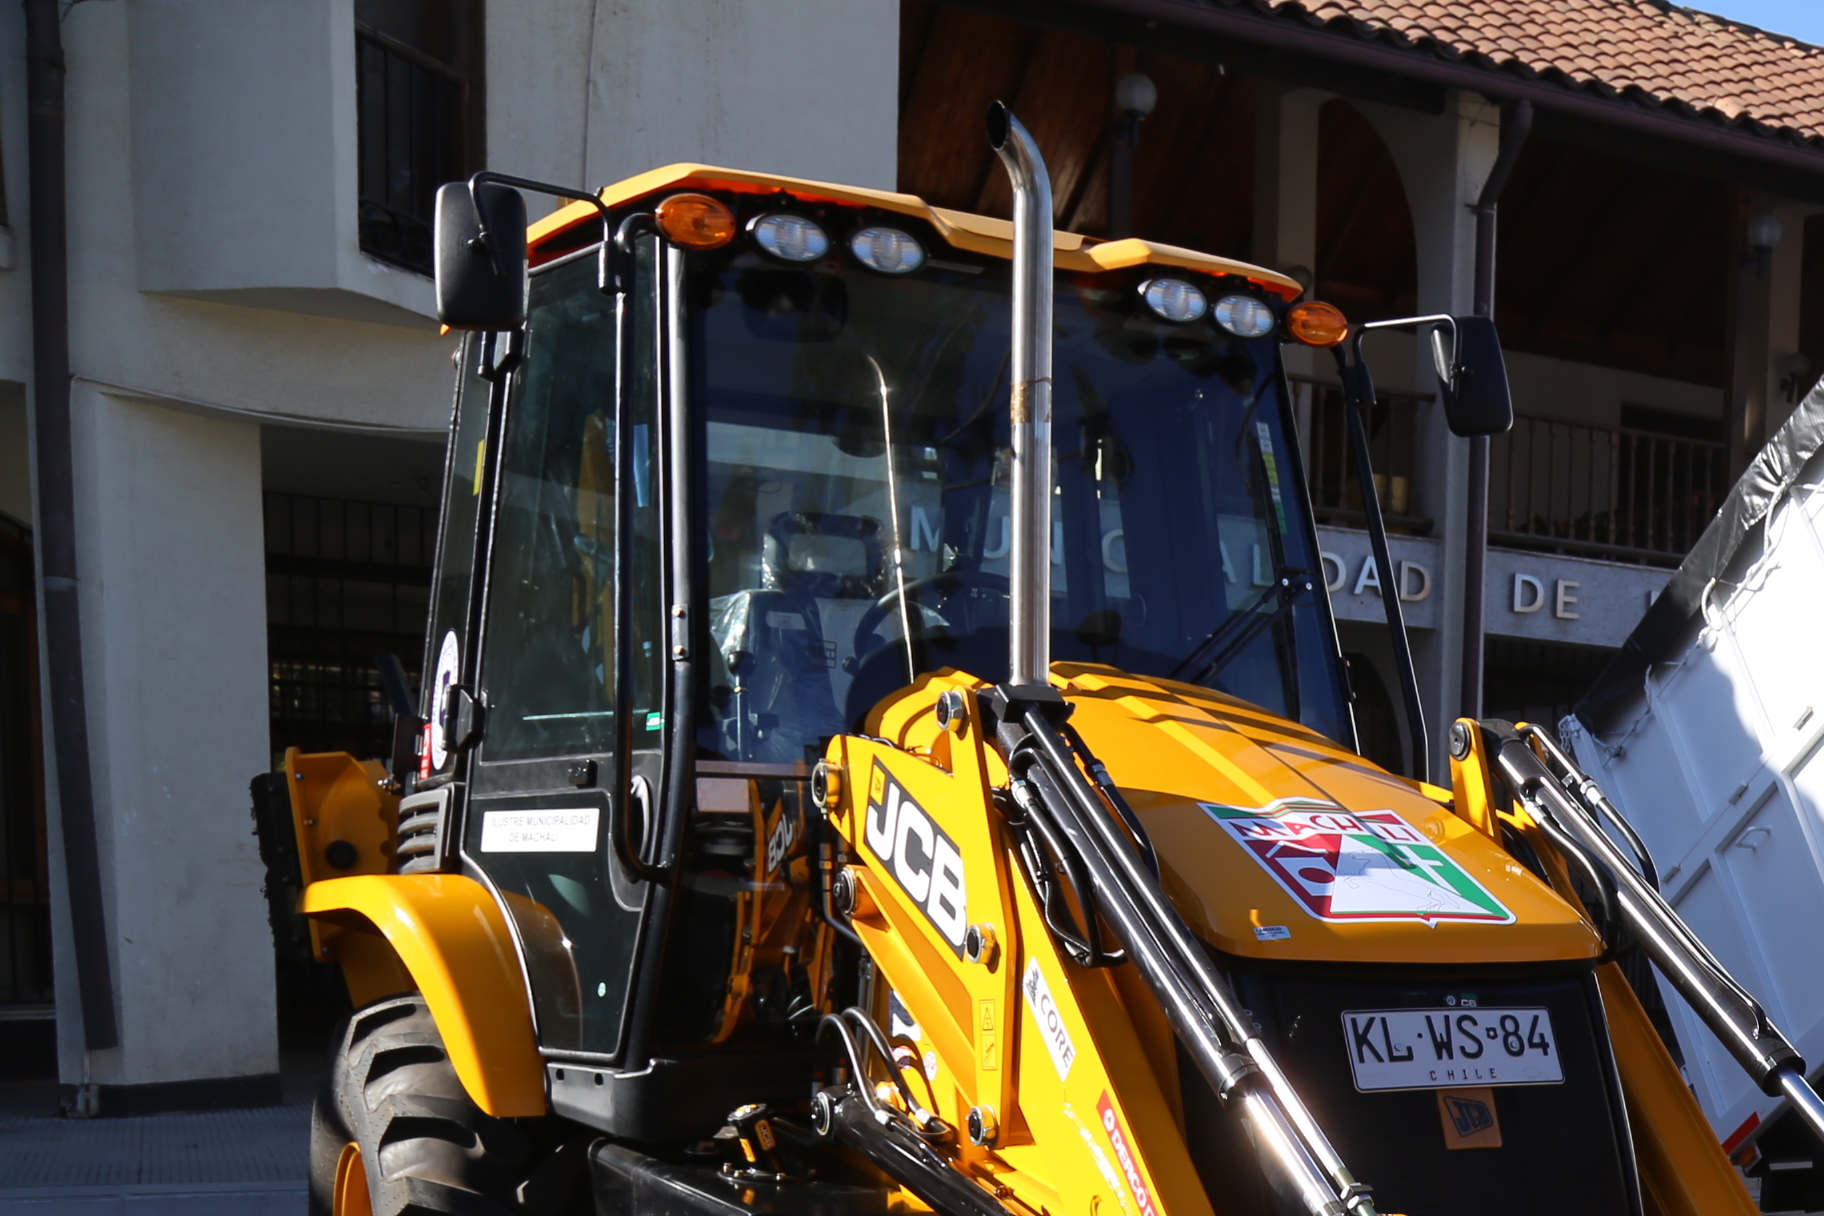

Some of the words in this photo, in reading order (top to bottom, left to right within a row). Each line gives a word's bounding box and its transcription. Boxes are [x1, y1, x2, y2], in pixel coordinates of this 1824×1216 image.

[1514, 573, 1580, 619] DE
[491, 817, 524, 827] ILUSTRE
[526, 815, 591, 827] MUNICIPALIDAD
[508, 832, 519, 843] DE
[866, 782, 967, 947] JCB
[1041, 993, 1074, 1069] CORE
[1430, 1068, 1498, 1082] CHILE
[1453, 1100, 1493, 1132] JCB
